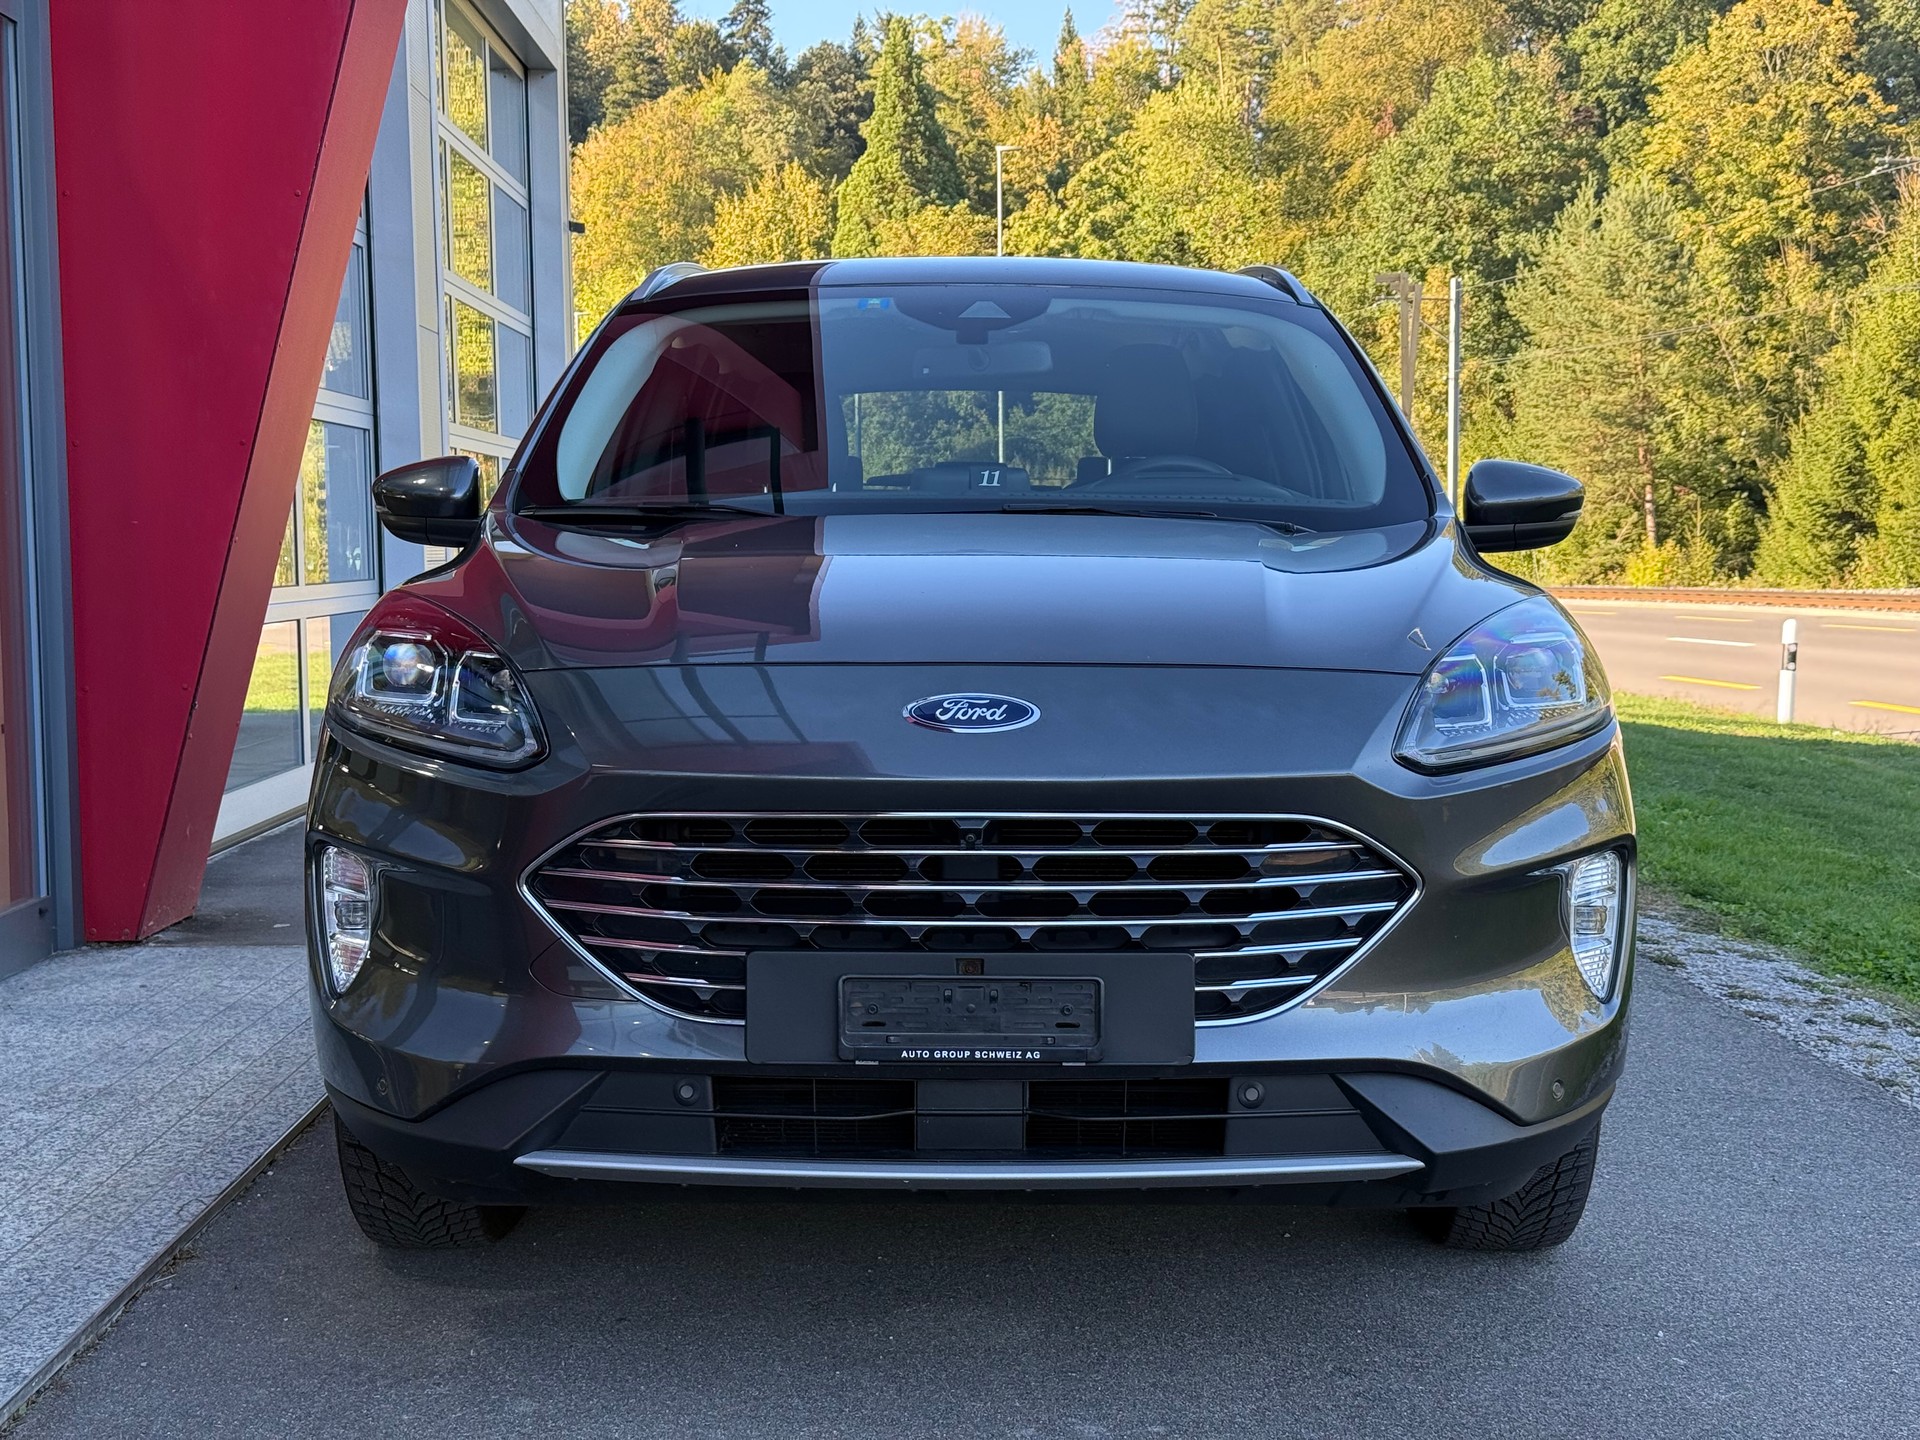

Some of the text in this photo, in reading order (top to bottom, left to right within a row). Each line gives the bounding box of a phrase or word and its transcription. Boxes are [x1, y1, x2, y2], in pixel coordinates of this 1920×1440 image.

[935, 698, 1008, 721] Ford
[901, 1050, 1041, 1059] AUTO GROUP SCHWEIZ AG
